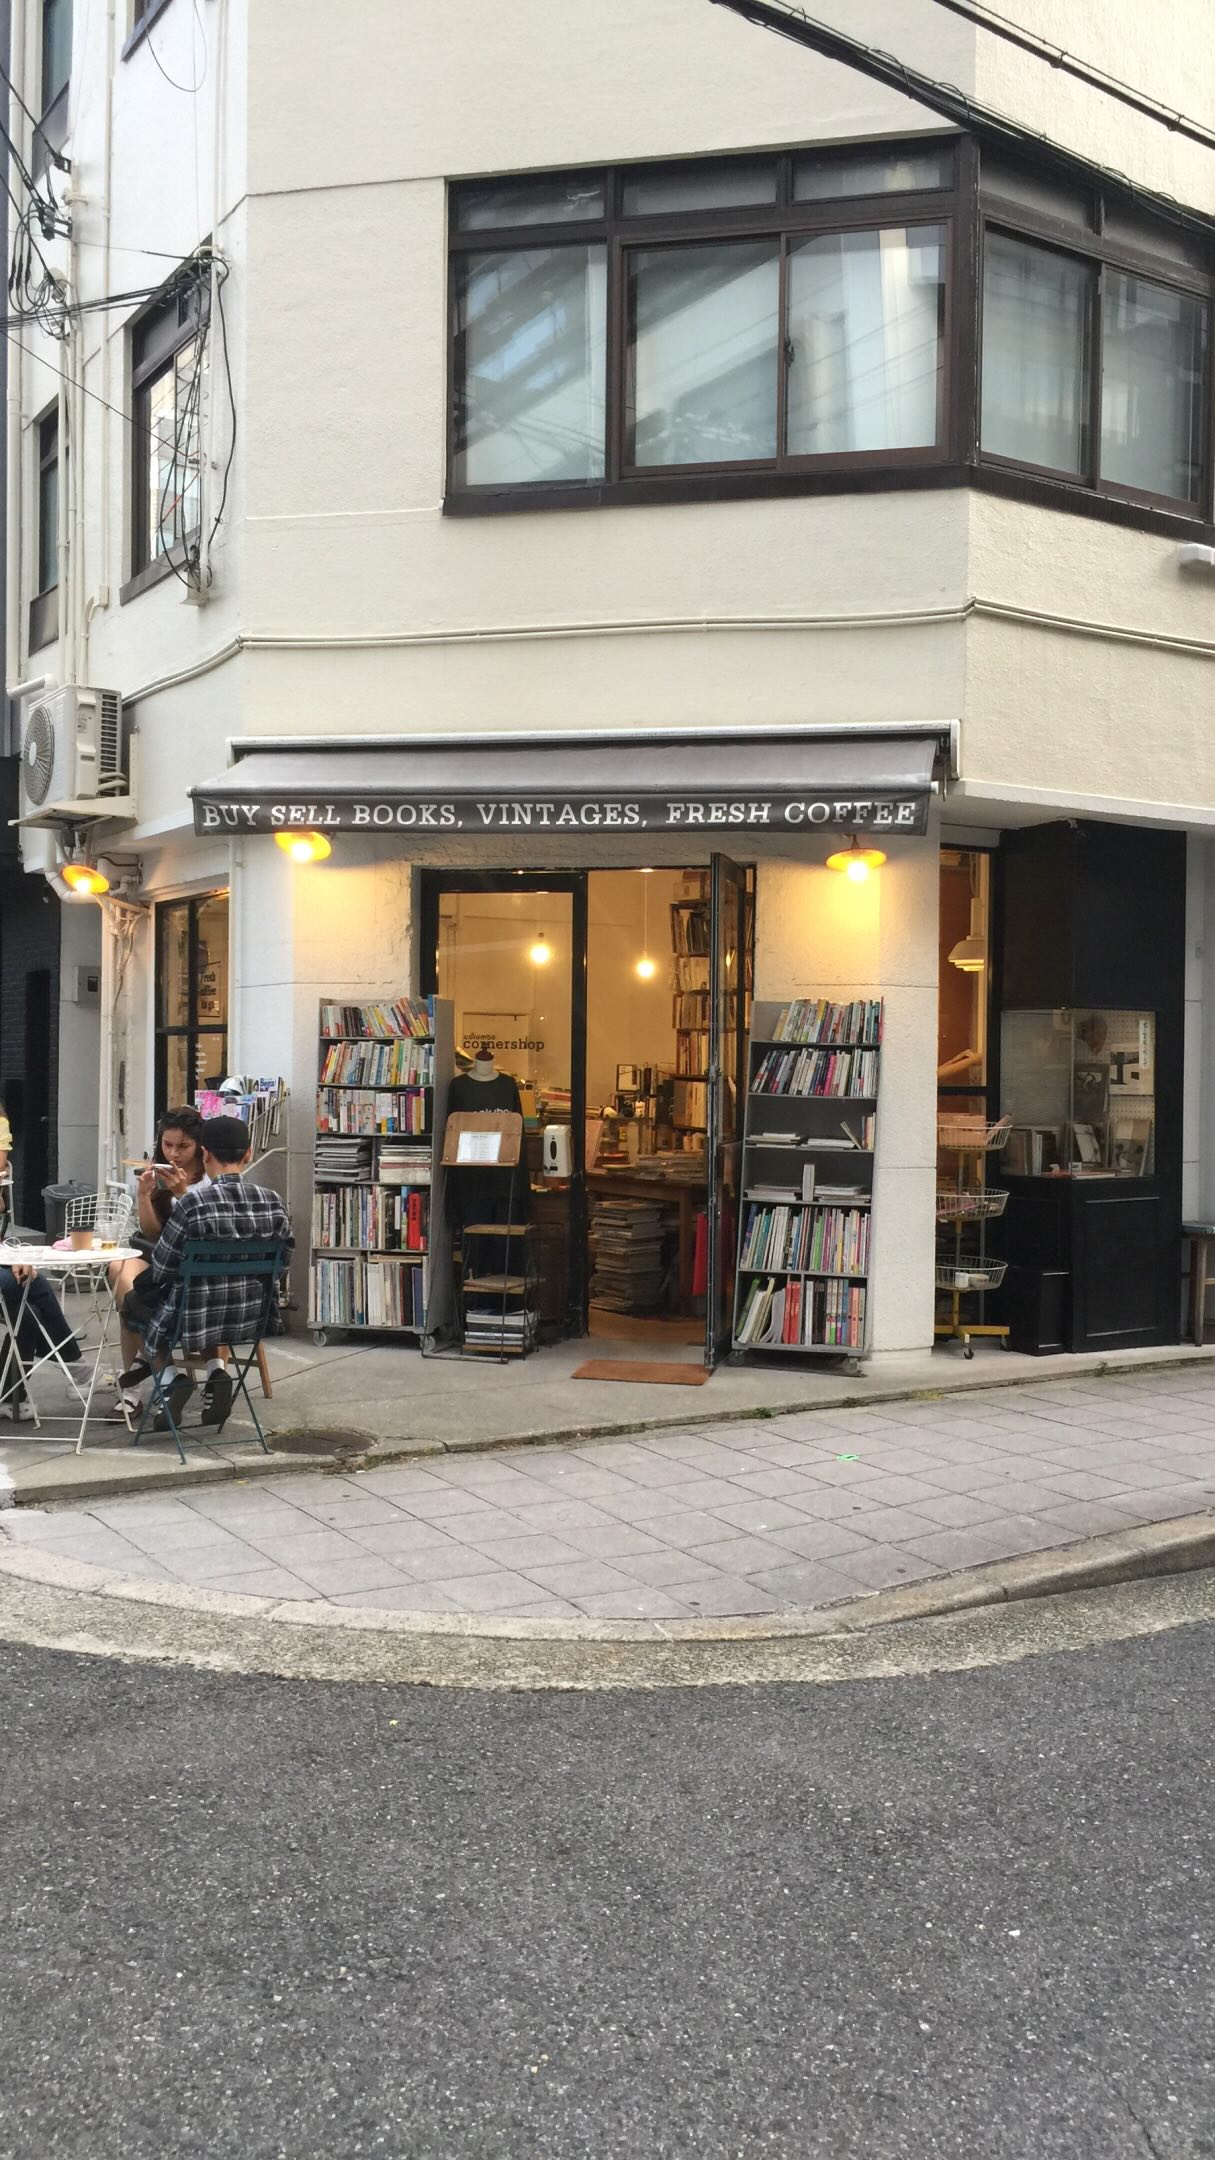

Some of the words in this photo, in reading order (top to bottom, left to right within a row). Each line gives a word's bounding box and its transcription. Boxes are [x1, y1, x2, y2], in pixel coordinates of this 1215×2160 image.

[202, 804, 261, 827] BUY
[270, 805, 341, 826] SELL
[351, 804, 464, 828] BOOKS,
[475, 802, 649, 827] VINTAGES,
[665, 802, 771, 823] FRESH
[783, 801, 917, 824] COFFEE
[463, 1038, 545, 1051] cornershop
